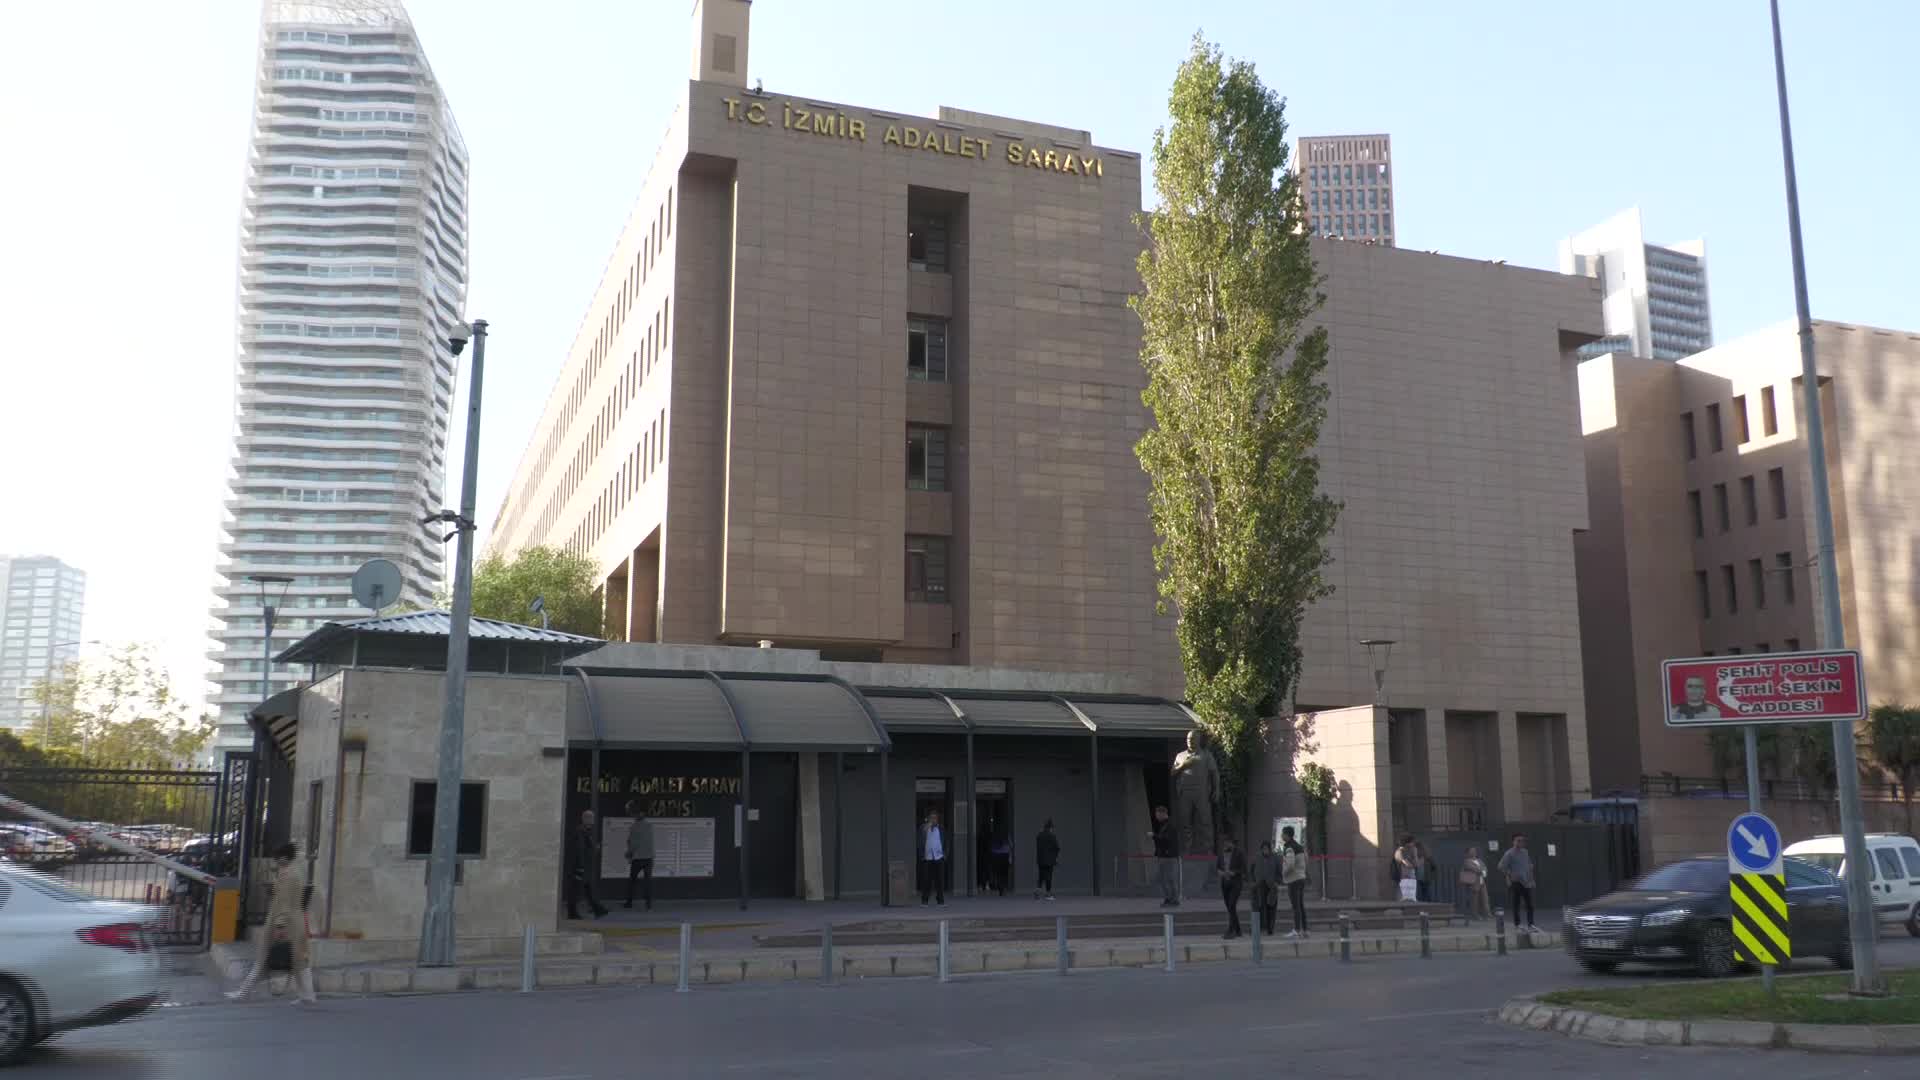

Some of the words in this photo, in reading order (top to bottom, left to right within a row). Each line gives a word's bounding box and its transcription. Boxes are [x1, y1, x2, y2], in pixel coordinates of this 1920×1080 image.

[723, 98, 773, 127] T.C.
[784, 102, 866, 141] İZMİR
[883, 125, 992, 160] ADALET
[1007, 143, 1103, 177] SARAYI
[1718, 664, 1773, 681] ŞEHİT
[1781, 659, 1839, 675] POLİS
[1719, 681, 1772, 697] FETHİ
[1780, 678, 1841, 696] ŞEKİN
[1739, 698, 1823, 714] CADDESİ
[630, 776, 684, 794] ADALET
[691, 776, 741, 793] SARAYI
